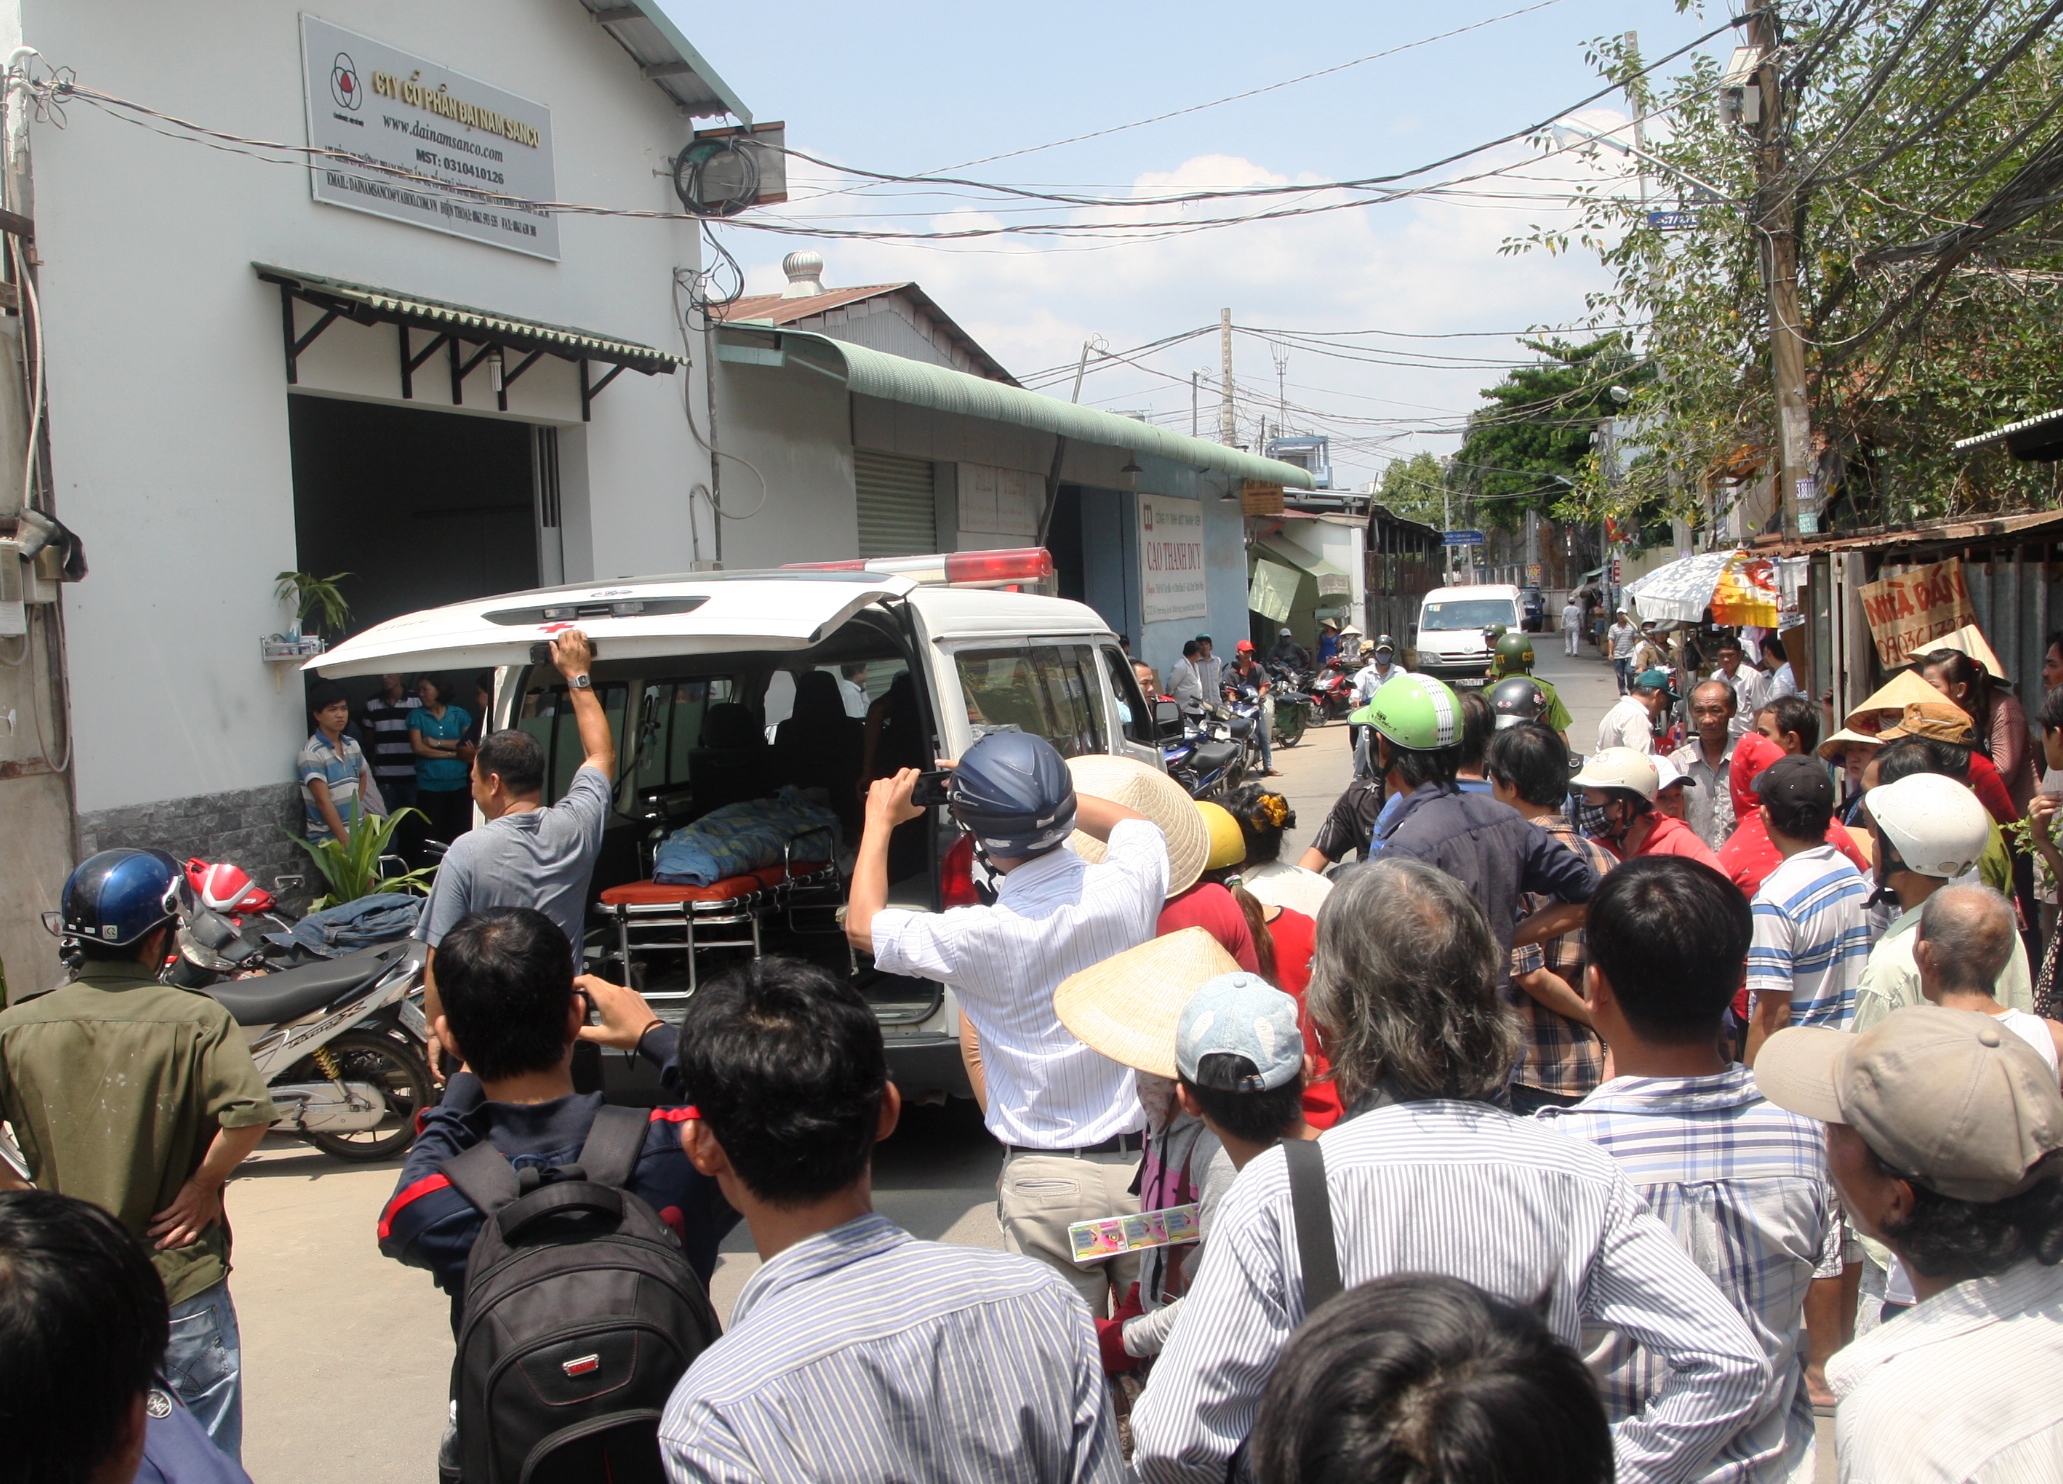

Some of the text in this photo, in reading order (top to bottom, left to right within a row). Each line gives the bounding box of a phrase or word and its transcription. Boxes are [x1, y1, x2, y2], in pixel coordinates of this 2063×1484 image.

[372, 70, 400, 100] CTY
[479, 108, 505, 137] NAM
[505, 117, 541, 151] SANCO
[383, 115, 504, 163] www.dainamsanco.com
[416, 148, 441, 168] MST:
[443, 157, 504, 185] 0310410126
[1147, 541, 1201, 571] CAO THANH DUY
[1864, 563, 1967, 627] NHÀ BÁN
